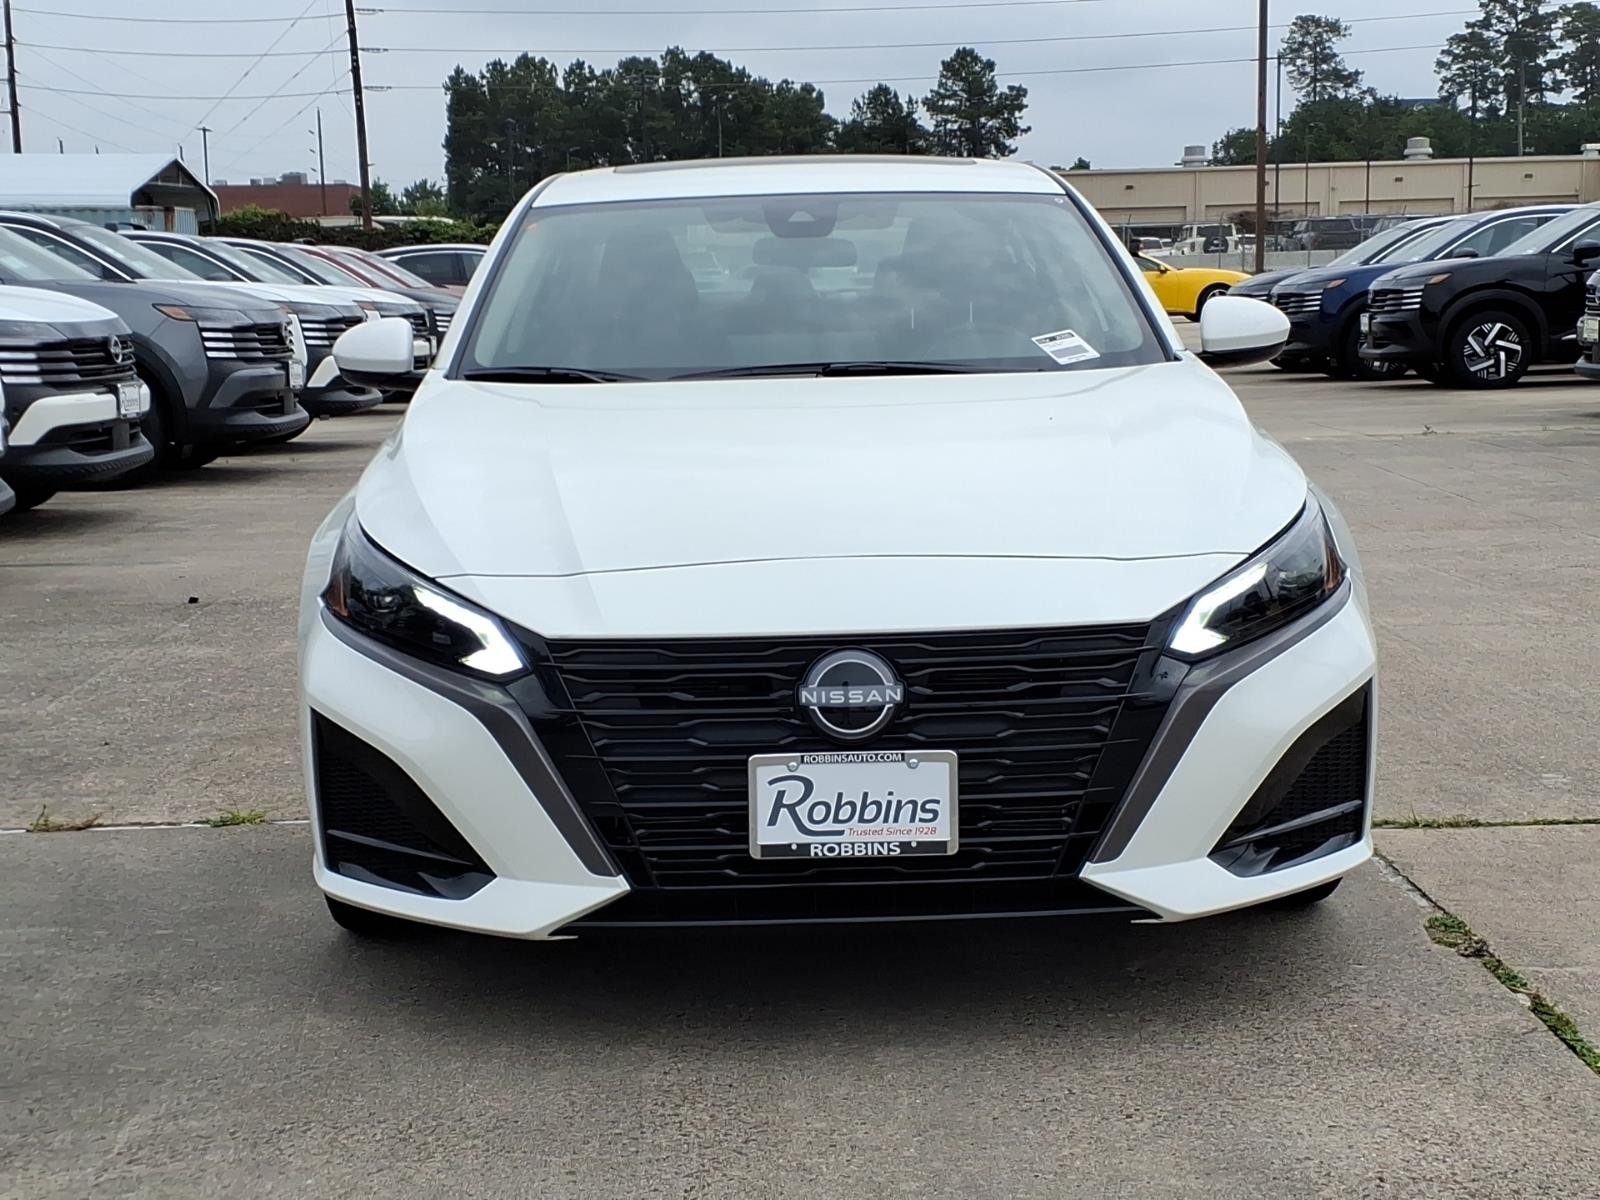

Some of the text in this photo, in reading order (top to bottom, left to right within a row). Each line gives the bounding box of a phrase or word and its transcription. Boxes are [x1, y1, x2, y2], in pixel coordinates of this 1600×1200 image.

[801, 688, 901, 704] NISSAN
[803, 753, 902, 764] ROBBINSAUTO.COM
[766, 774, 941, 837] Robbins
[847, 826, 937, 837] Trusted Since 1928
[810, 842, 901, 857] ROBBINS
